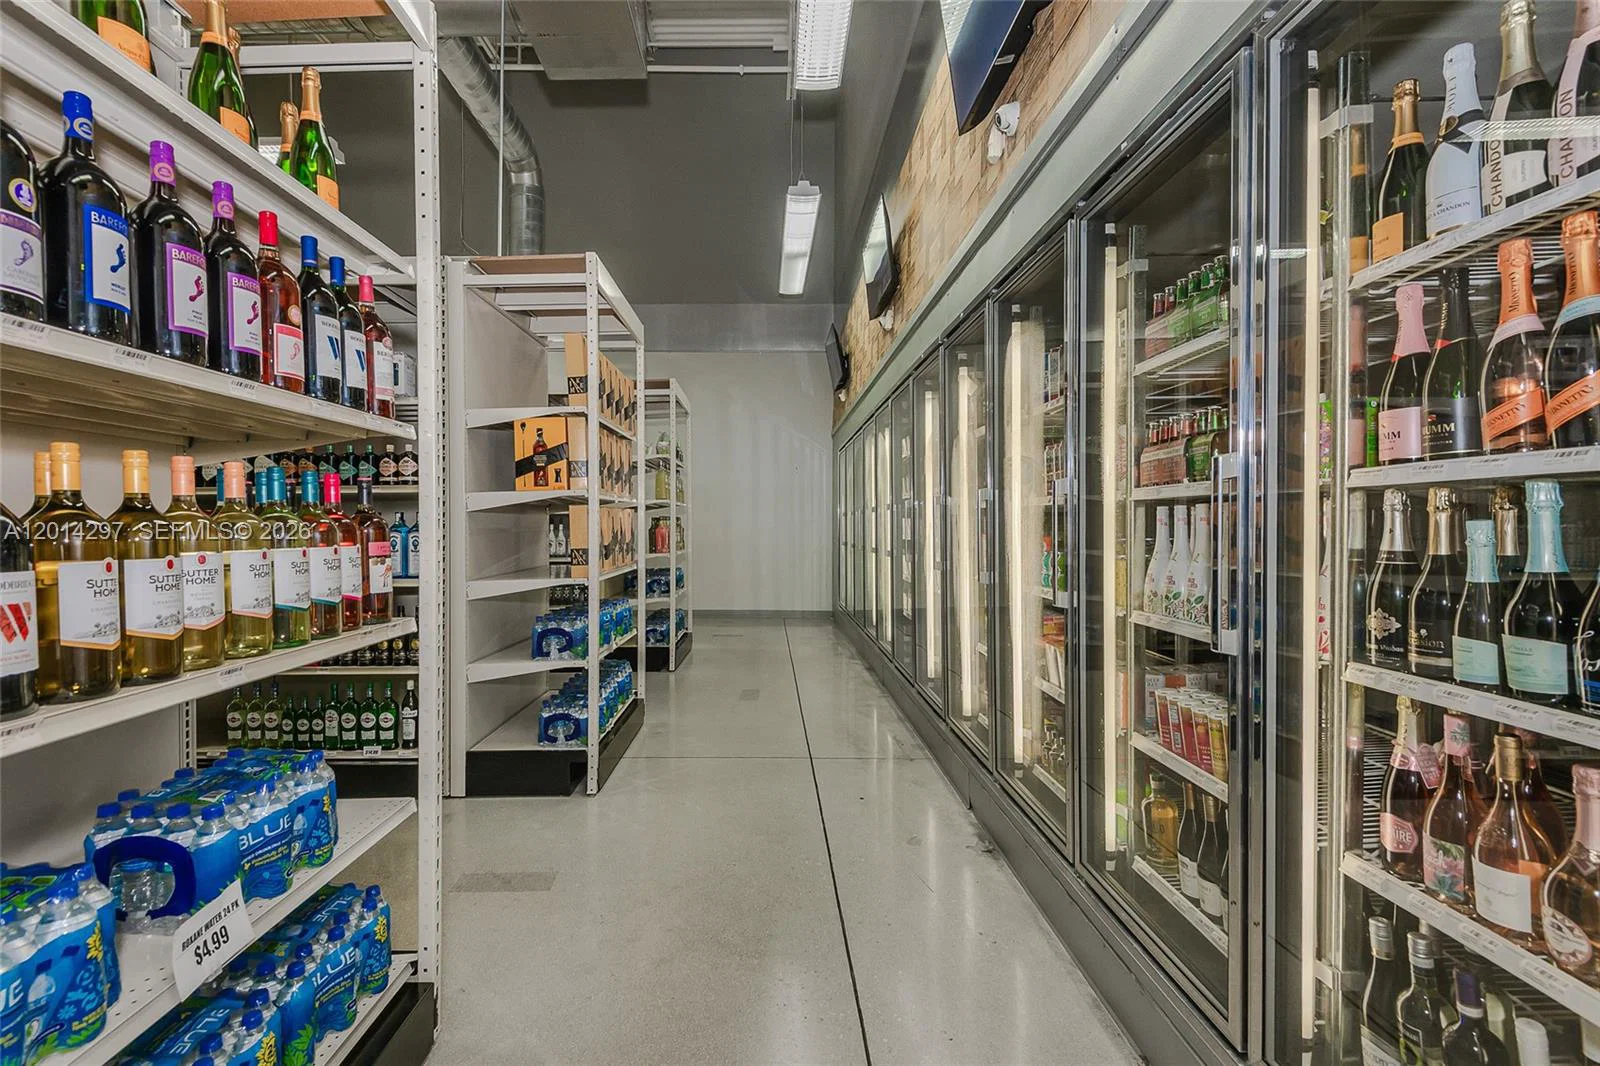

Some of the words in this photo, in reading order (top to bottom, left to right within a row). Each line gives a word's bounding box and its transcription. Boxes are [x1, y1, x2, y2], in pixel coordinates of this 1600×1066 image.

[1560, 88, 1574, 179] CHAON
[1489, 131, 1503, 208] CHANDO
[181, 568, 219, 578] SUTTER
[249, 563, 271, 572] SUTT
[155, 583, 181, 593] HOME
[185, 577, 217, 585] HOME
[93, 588, 117, 598] HOM
[239, 813, 292, 851] BLUE
[203, 911, 224, 933] WATER
[222, 905, 231, 918] 24
[231, 898, 240, 912] PK
[194, 925, 230, 966] $4.99
